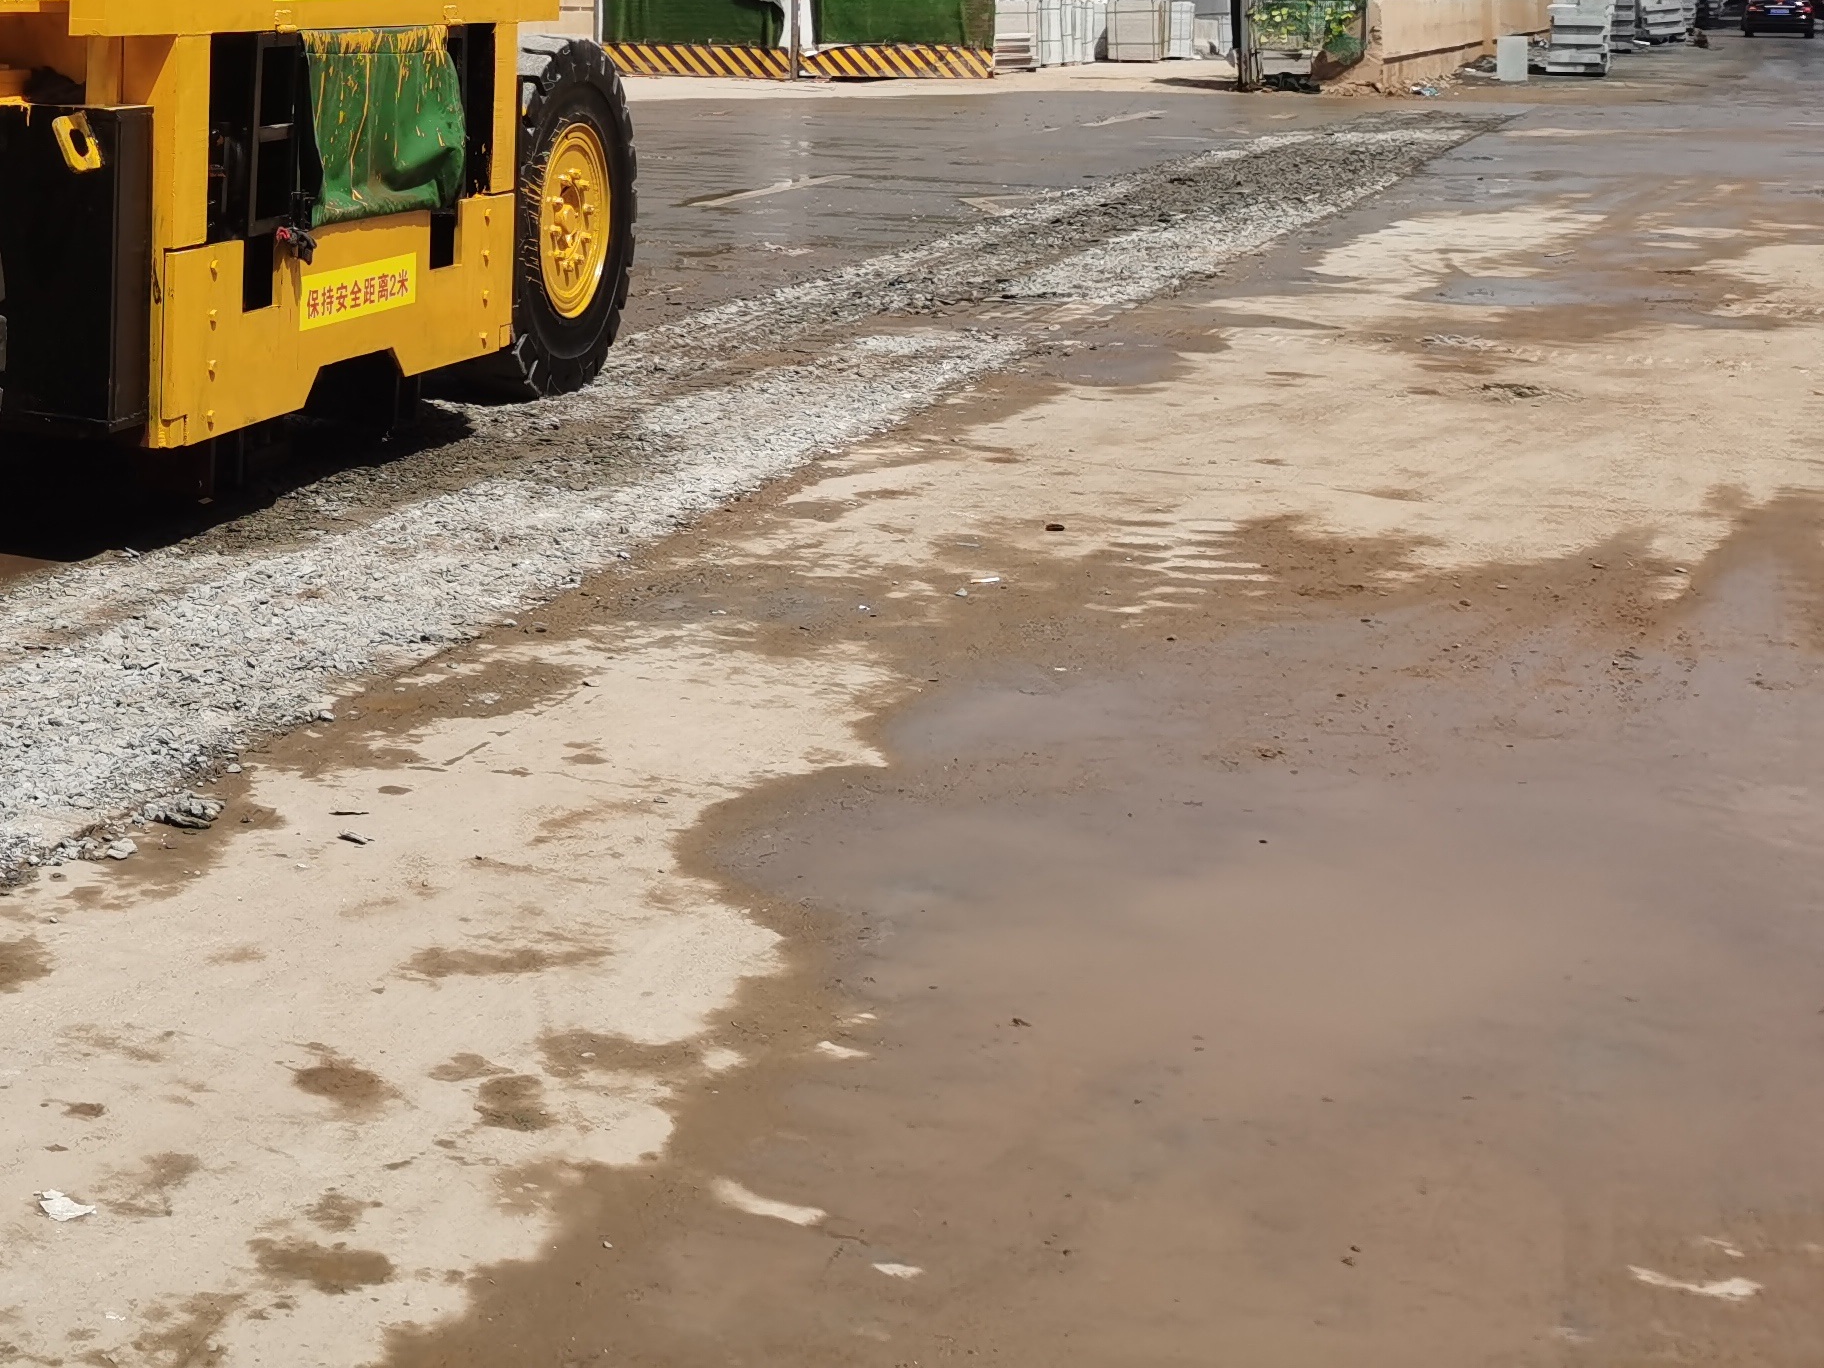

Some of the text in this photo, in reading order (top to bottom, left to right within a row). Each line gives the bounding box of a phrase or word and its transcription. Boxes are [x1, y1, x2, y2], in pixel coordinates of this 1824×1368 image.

[306, 268, 409, 320] 保持安全距离2米
